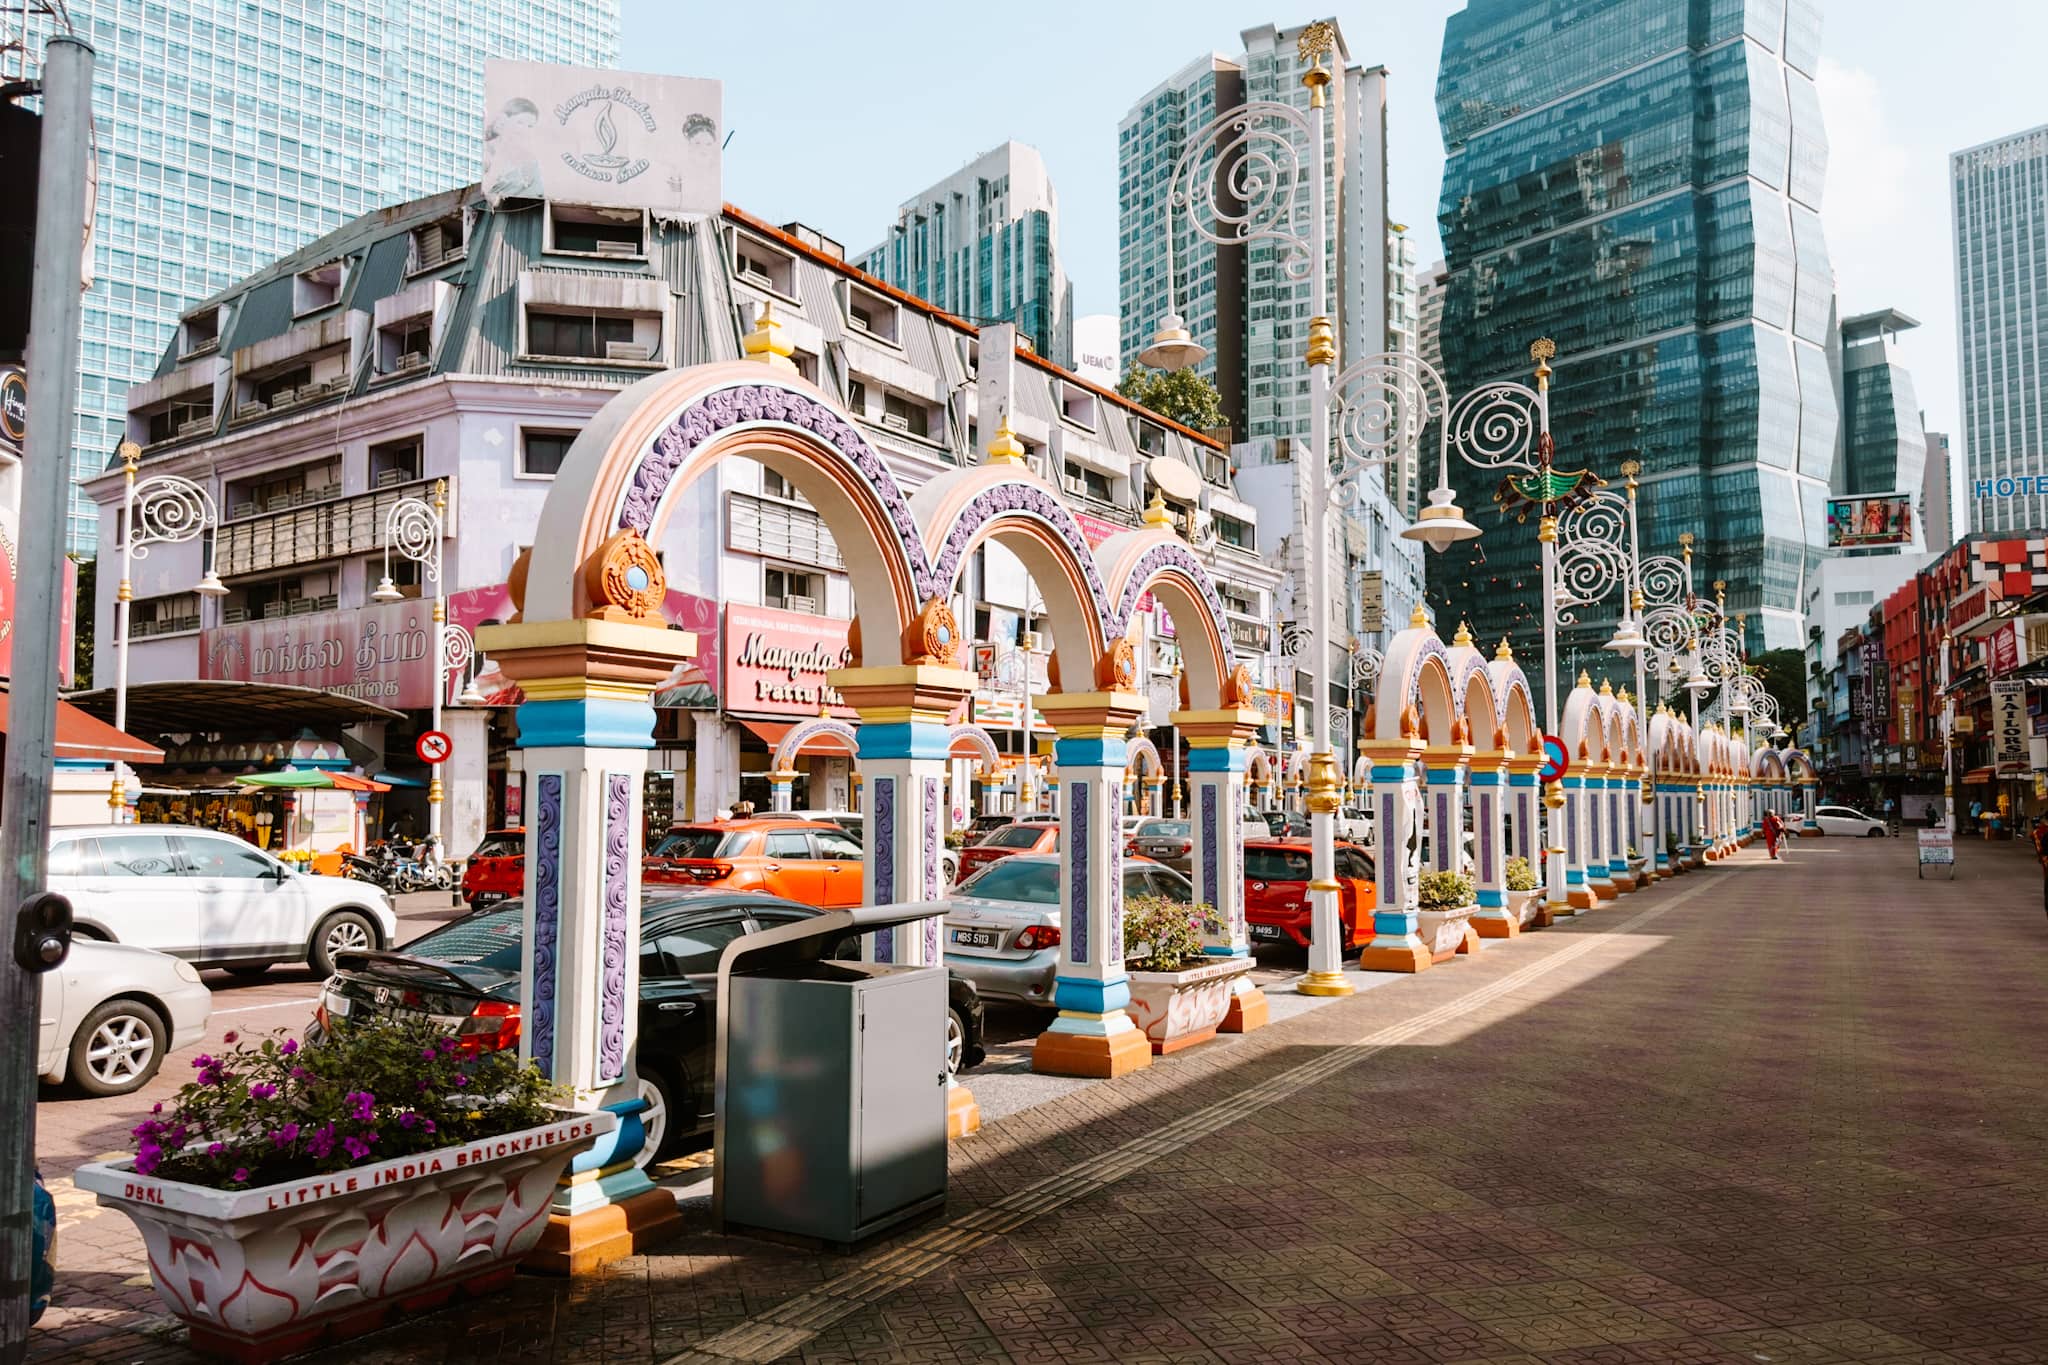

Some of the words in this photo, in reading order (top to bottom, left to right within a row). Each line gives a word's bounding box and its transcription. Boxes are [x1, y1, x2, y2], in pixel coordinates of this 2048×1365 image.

[1082, 353, 1104, 369] UEM
[253, 632, 343, 676] மங்கல
[354, 618, 428, 671] தீபம்
[737, 631, 835, 681] Mangala
[756, 679, 817, 703] Pattu
[2000, 693, 2022, 753] TAILORS
[268, 1178, 358, 1210] LITTLE
[374, 1158, 442, 1186] INDIA
[457, 1122, 593, 1166] BRICKFIELDS
[125, 1183, 164, 1205] DBKL
